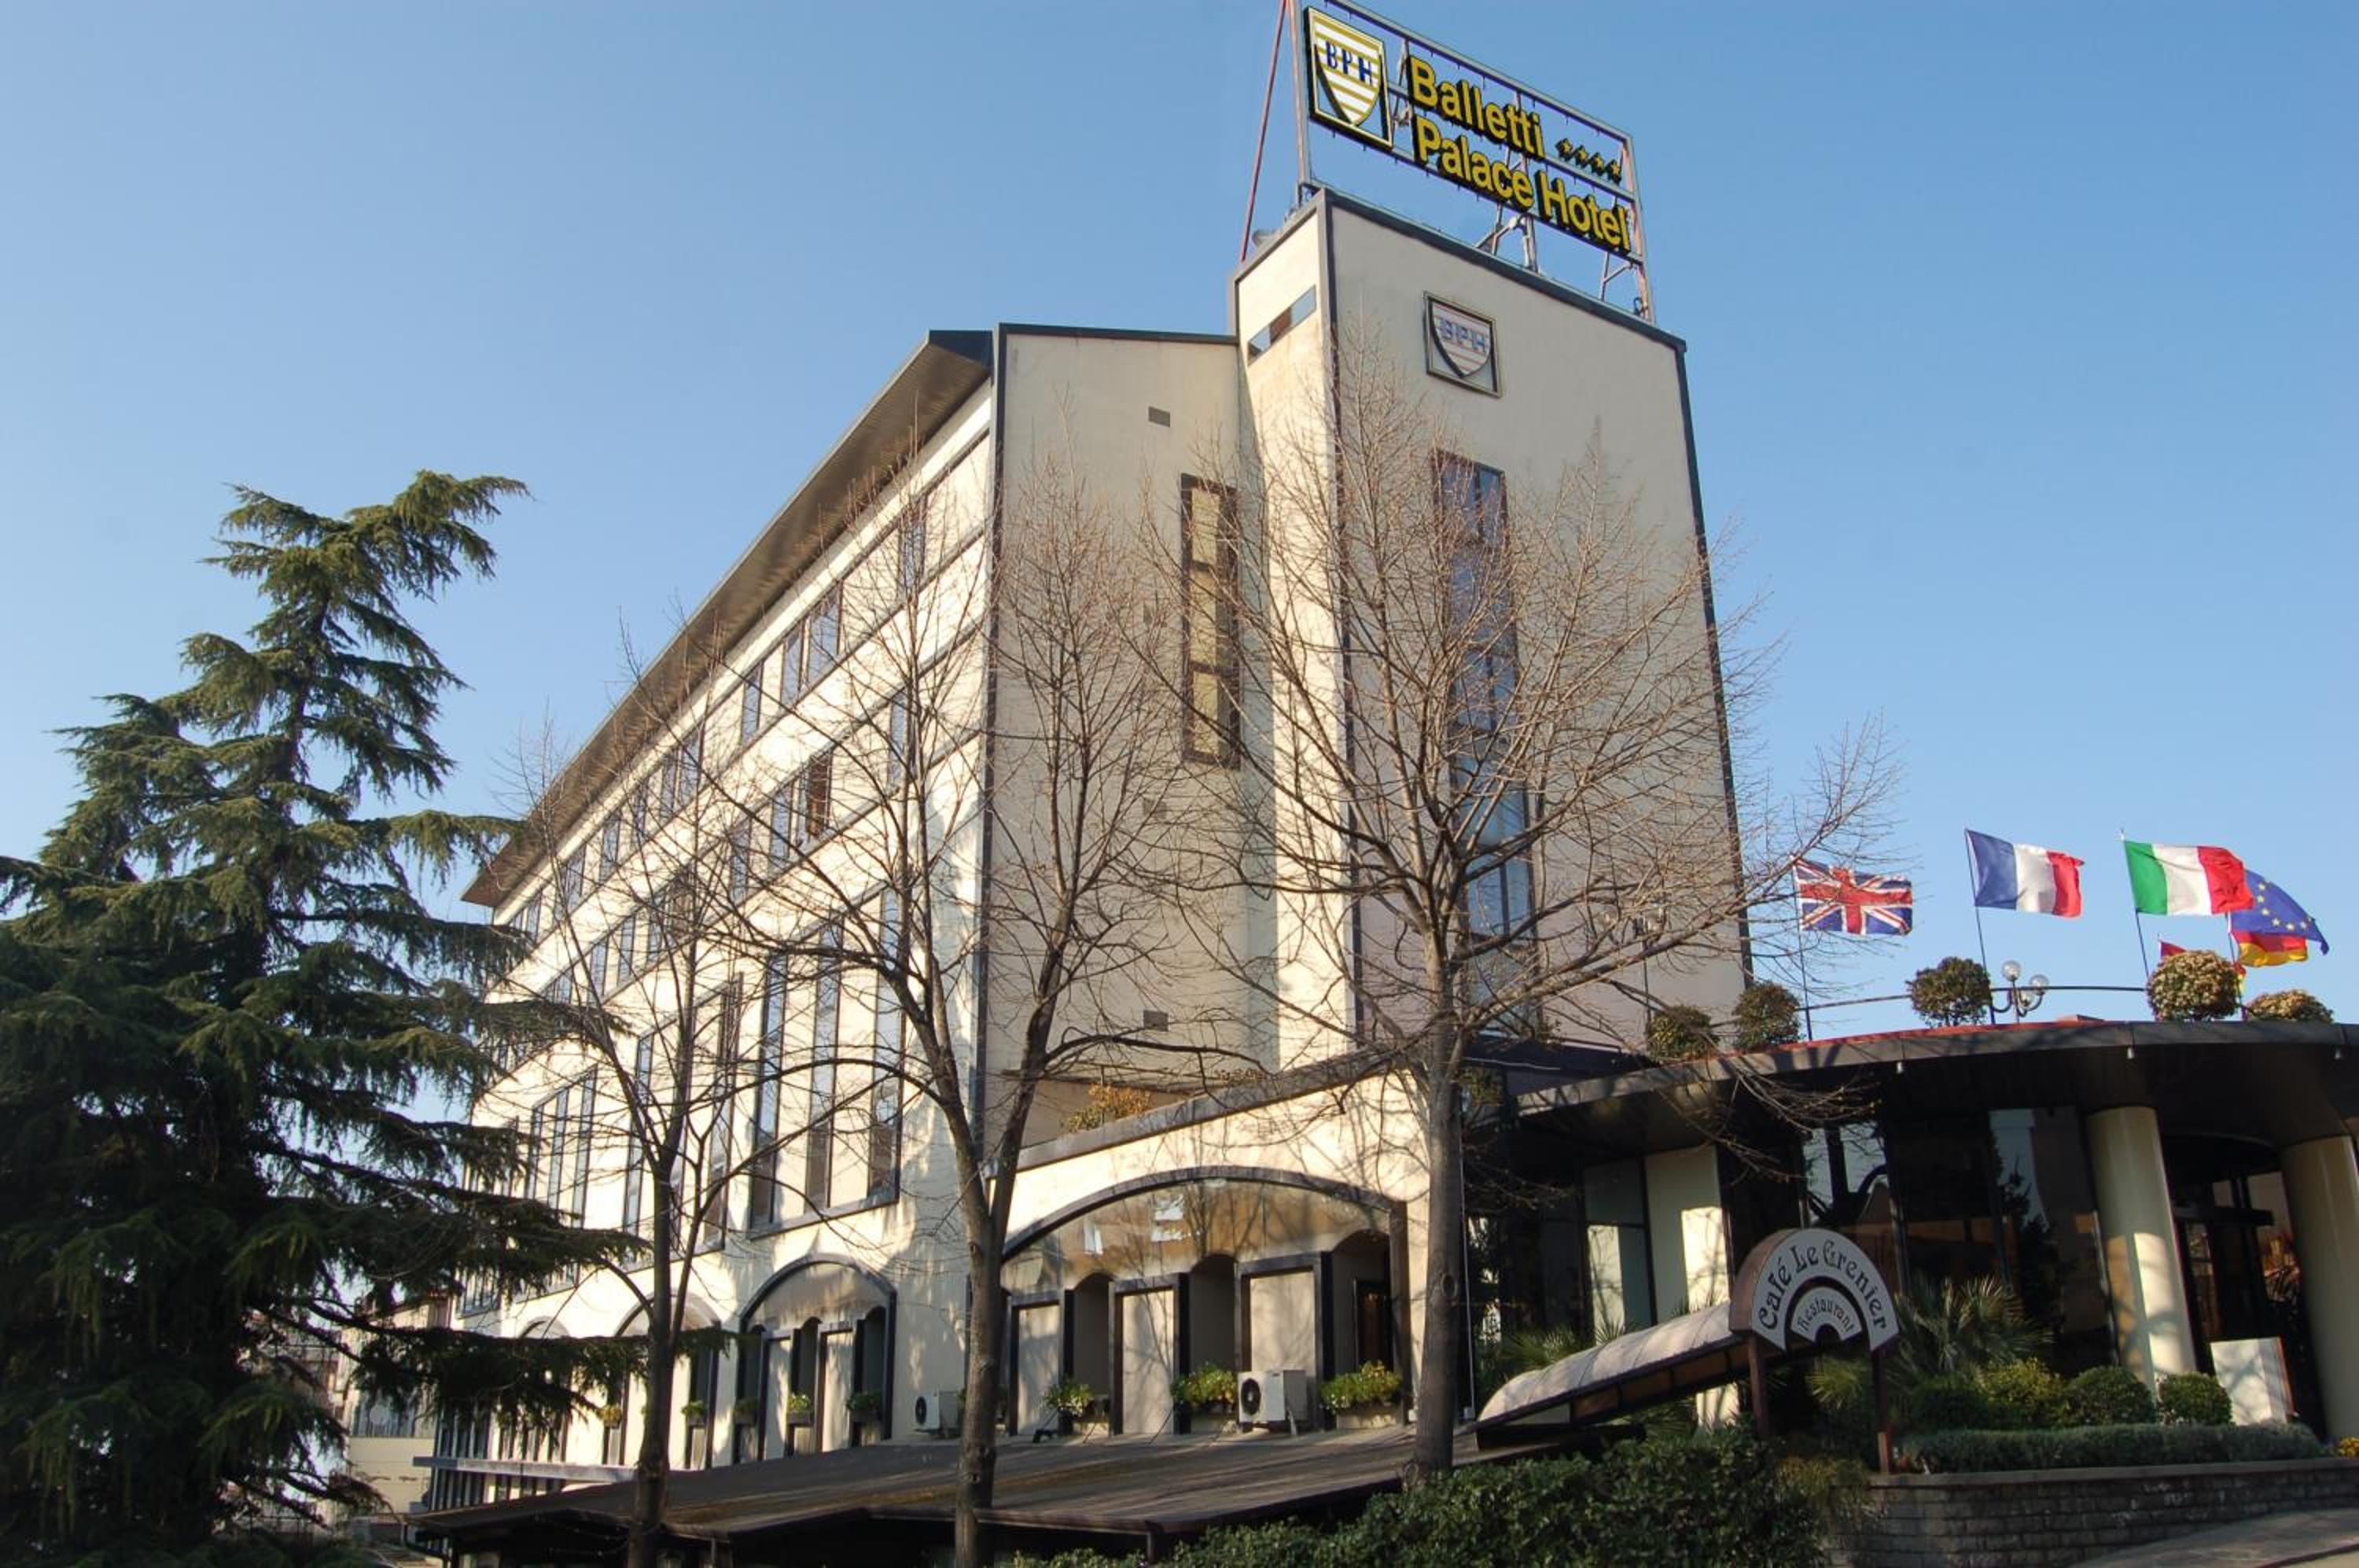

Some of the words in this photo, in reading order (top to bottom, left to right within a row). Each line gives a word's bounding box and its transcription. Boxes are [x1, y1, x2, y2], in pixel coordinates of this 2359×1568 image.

[1325, 40, 1375, 86] BPH
[1408, 54, 1545, 160] Balletti
[1415, 114, 1534, 212] Palace
[1535, 170, 1632, 254] Hotel
[1440, 318, 1486, 355] BPH
[1758, 1257, 1792, 1331] Café
[1790, 1245, 1819, 1274] Le
[1823, 1239, 1887, 1331] Grenier
[1797, 1297, 1855, 1333] Restaurant
